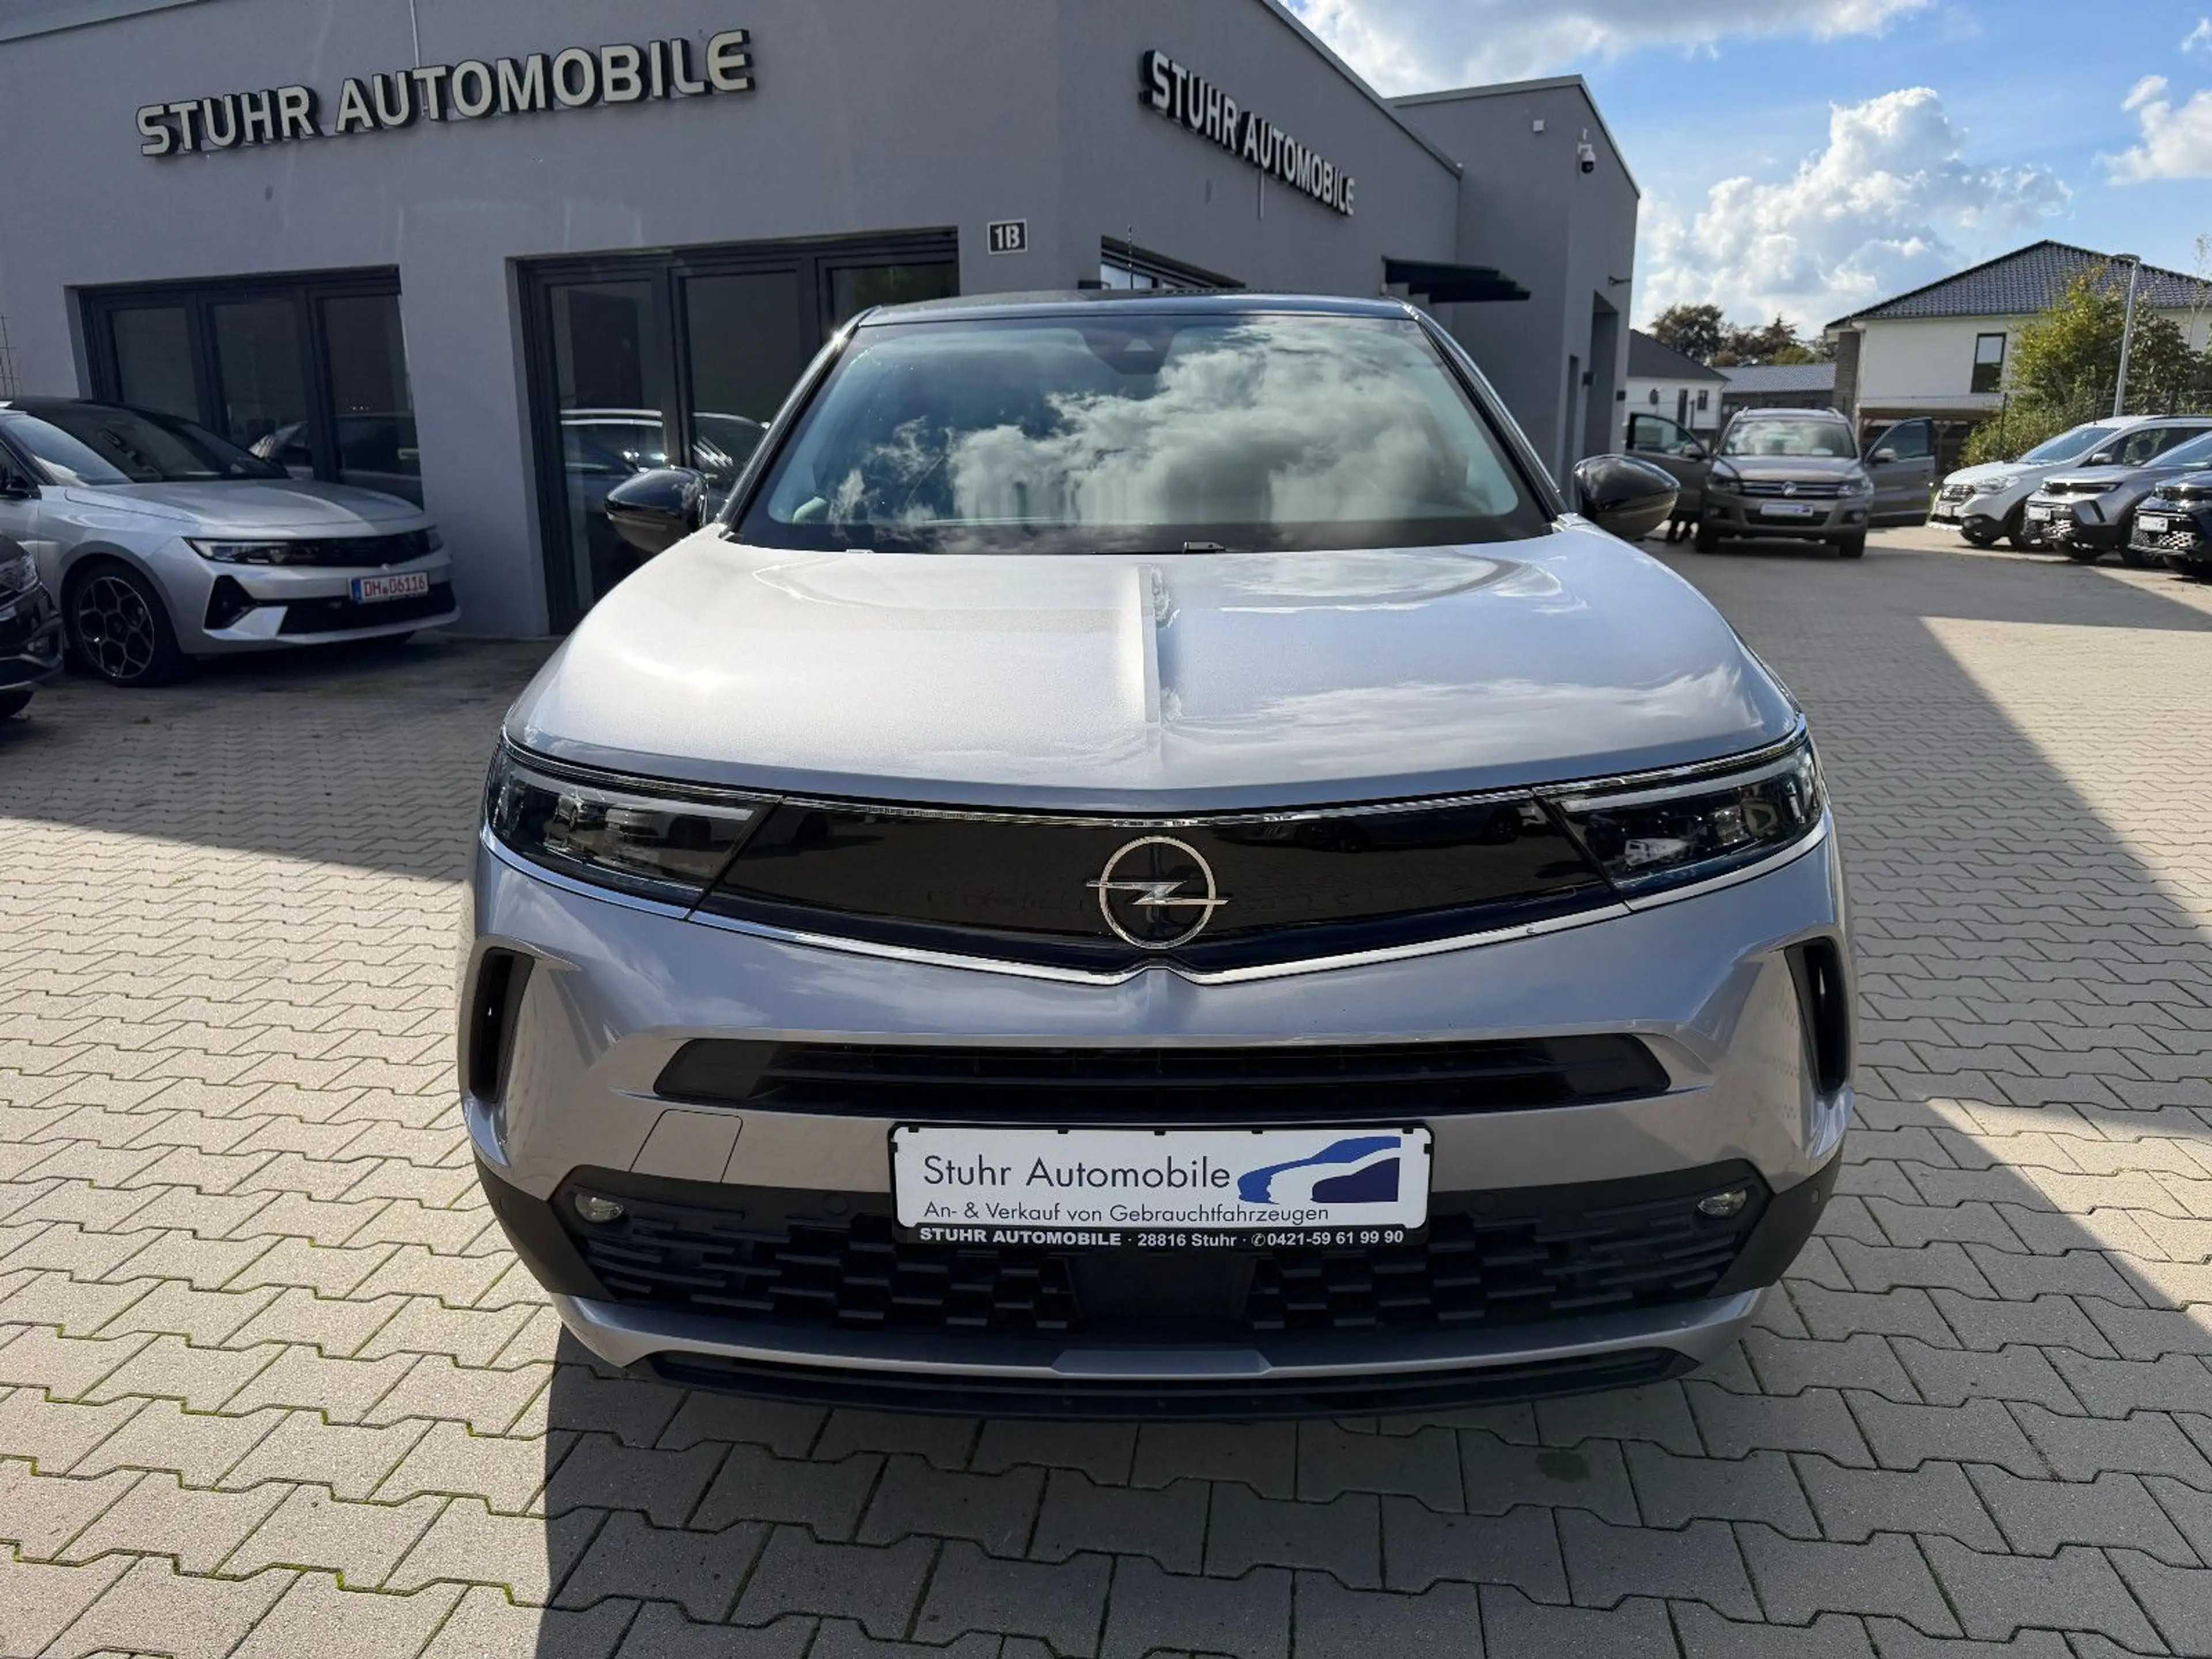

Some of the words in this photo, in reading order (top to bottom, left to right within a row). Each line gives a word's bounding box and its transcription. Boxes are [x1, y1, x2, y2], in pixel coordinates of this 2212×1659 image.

[137, 85, 319, 156] STUHR
[336, 29, 751, 133] AUTOMOBILE
[1147, 50, 1237, 150] STUHR
[1243, 112, 1355, 216] AUTOMOBILE
[995, 225, 1020, 249] 1B
[364, 577, 381, 597] DH
[923, 1154, 1012, 1185] Stuhr
[1025, 1156, 1230, 1188] Automobile
[924, 1201, 957, 1218] An-
[964, 1202, 979, 1219] &
[986, 1202, 1060, 1221] Verkauf
[1067, 1207, 1101, 1222] von
[1109, 1203, 1328, 1225] Gebrauchtfahrzeugen
[919, 1228, 987, 1243] STUHR
[992, 1230, 1122, 1246] AUTOMOBILE
[1138, 1233, 1186, 1247] 28816
[1191, 1234, 1236, 1247] Stuhr
[1267, 1232, 1331, 1247] 0421-59
[1335, 1231, 1354, 1245] 61
[1359, 1231, 1379, 1244] 99
[1384, 1230, 1404, 1244] 90
